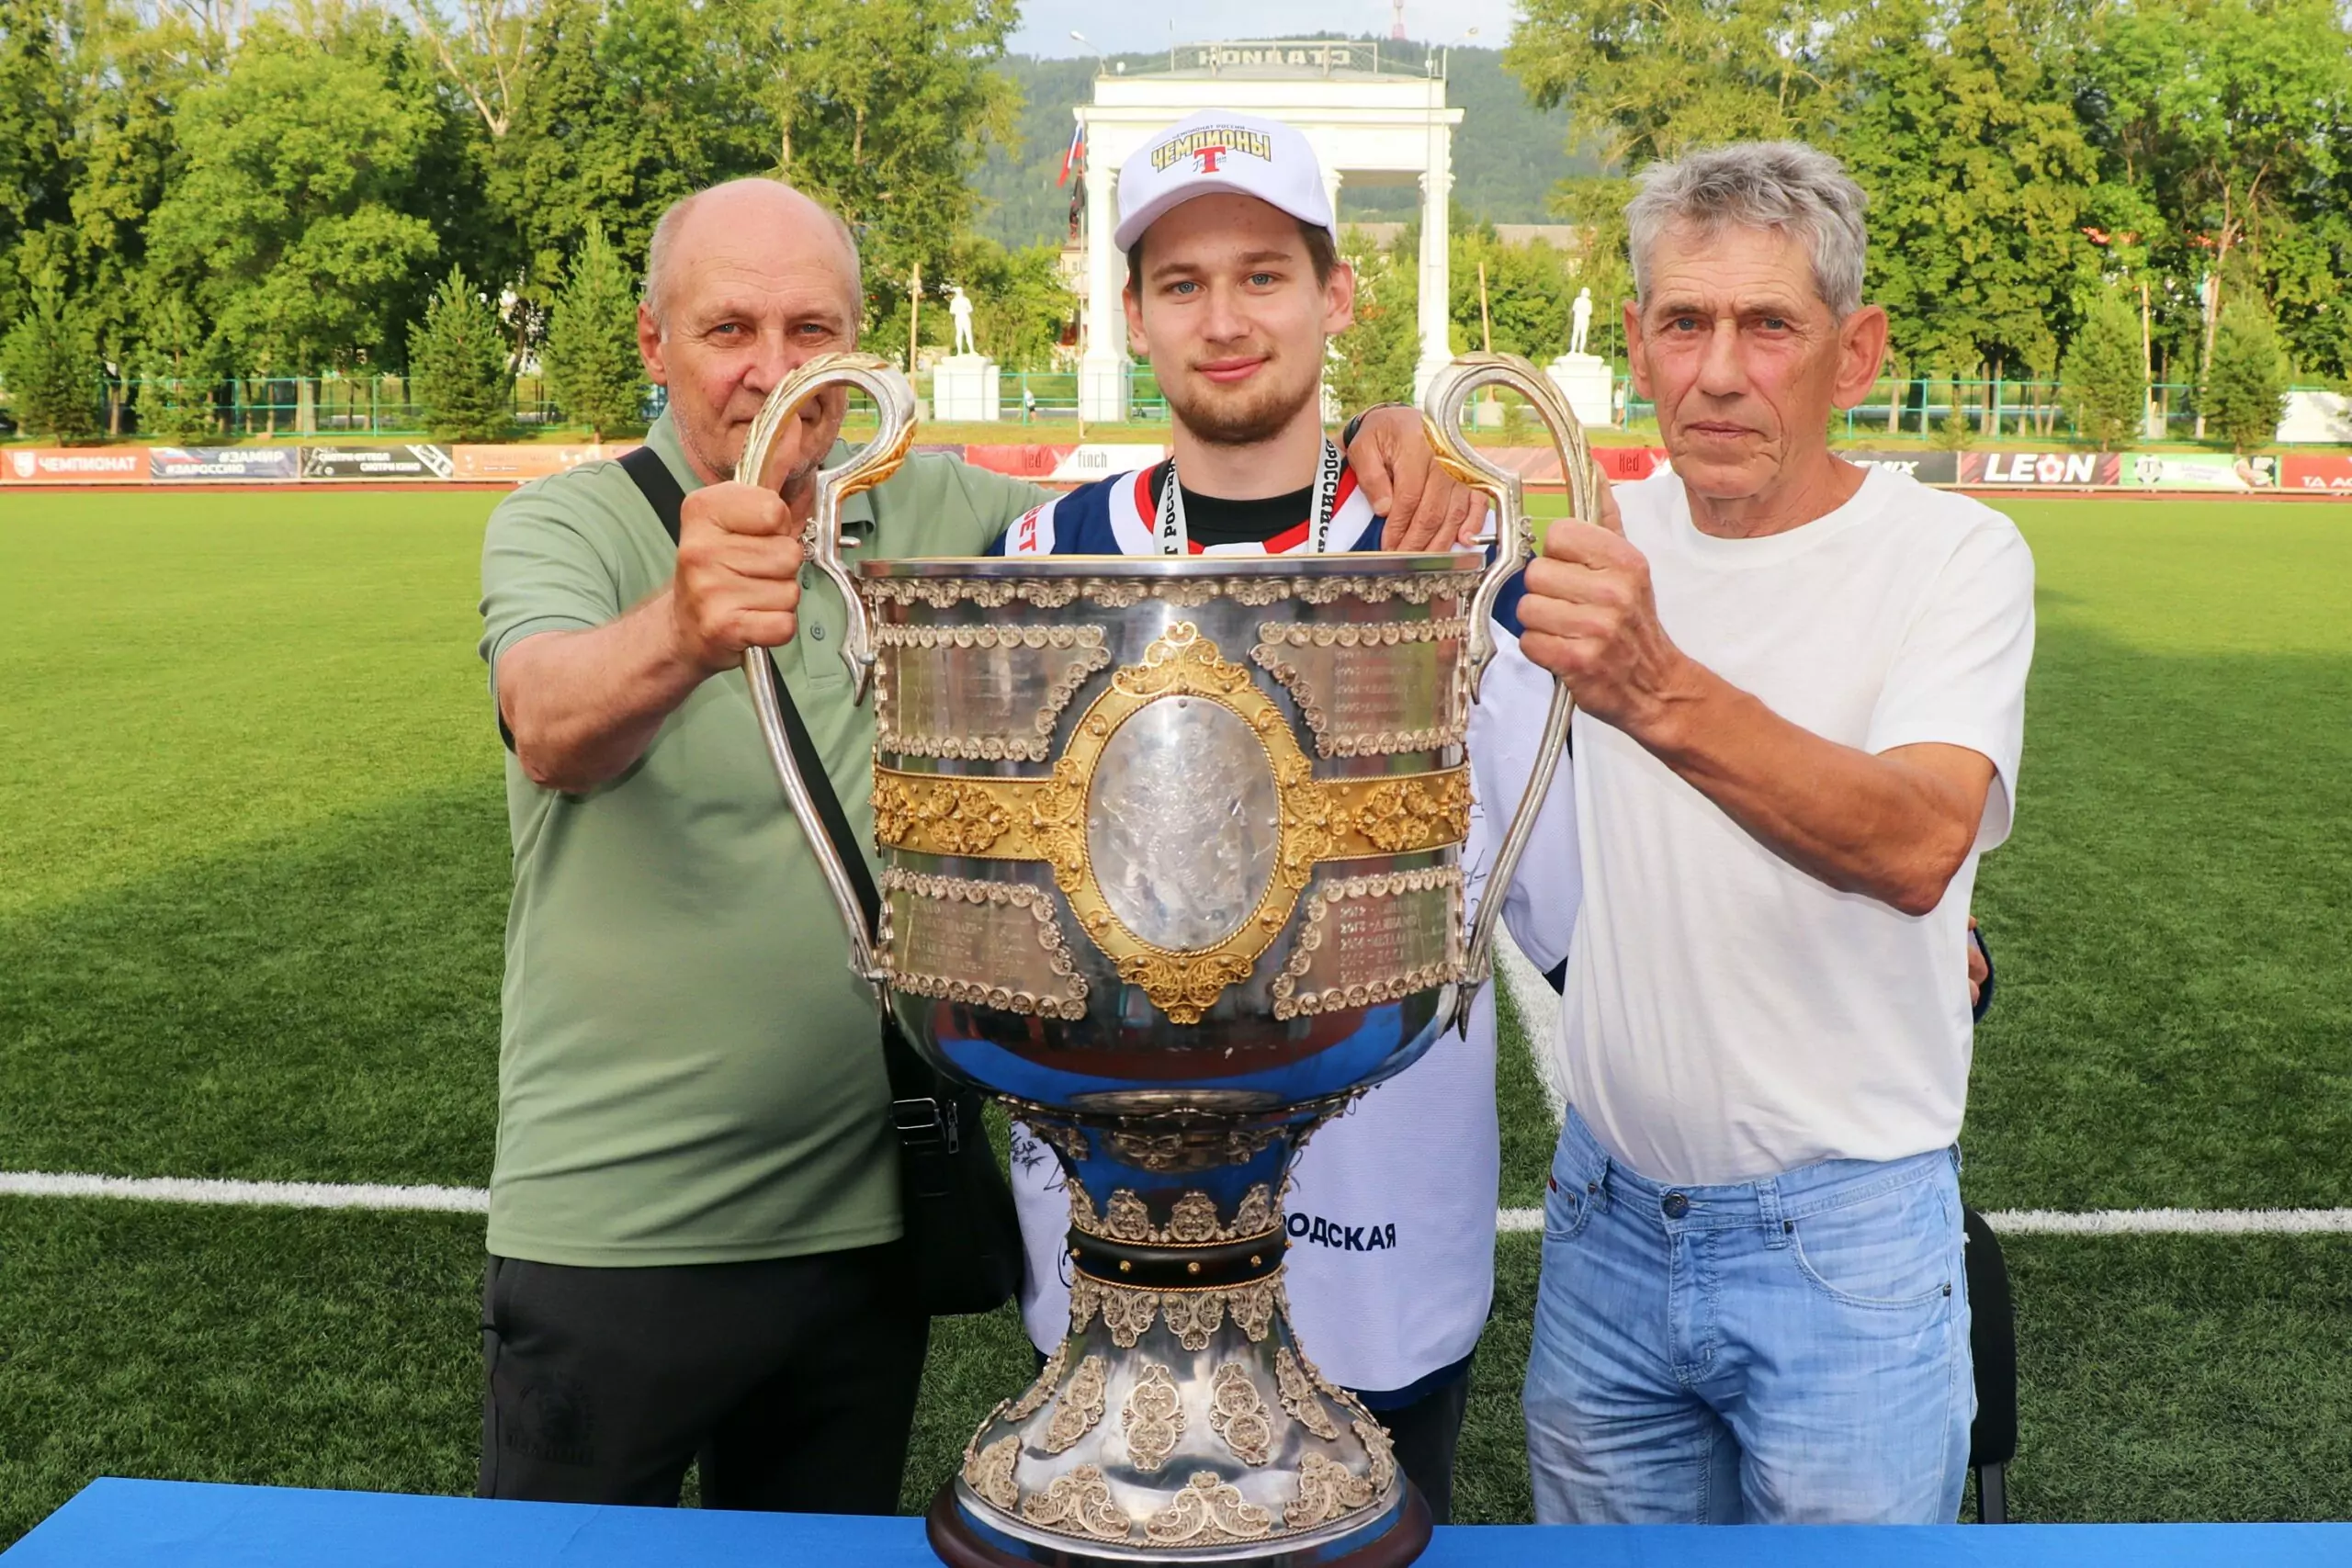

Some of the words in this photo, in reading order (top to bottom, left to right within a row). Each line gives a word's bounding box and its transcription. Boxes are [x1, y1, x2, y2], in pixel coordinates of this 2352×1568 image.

[1151, 129, 1272, 173] ЧЕМПИОНЫ
[39, 457, 137, 472] ЧЕМПИОНАТ
[1078, 451, 1107, 468] finch
[1984, 453, 2097, 483] LEON
[1283, 1213, 1396, 1251] ОДСКАЯ
